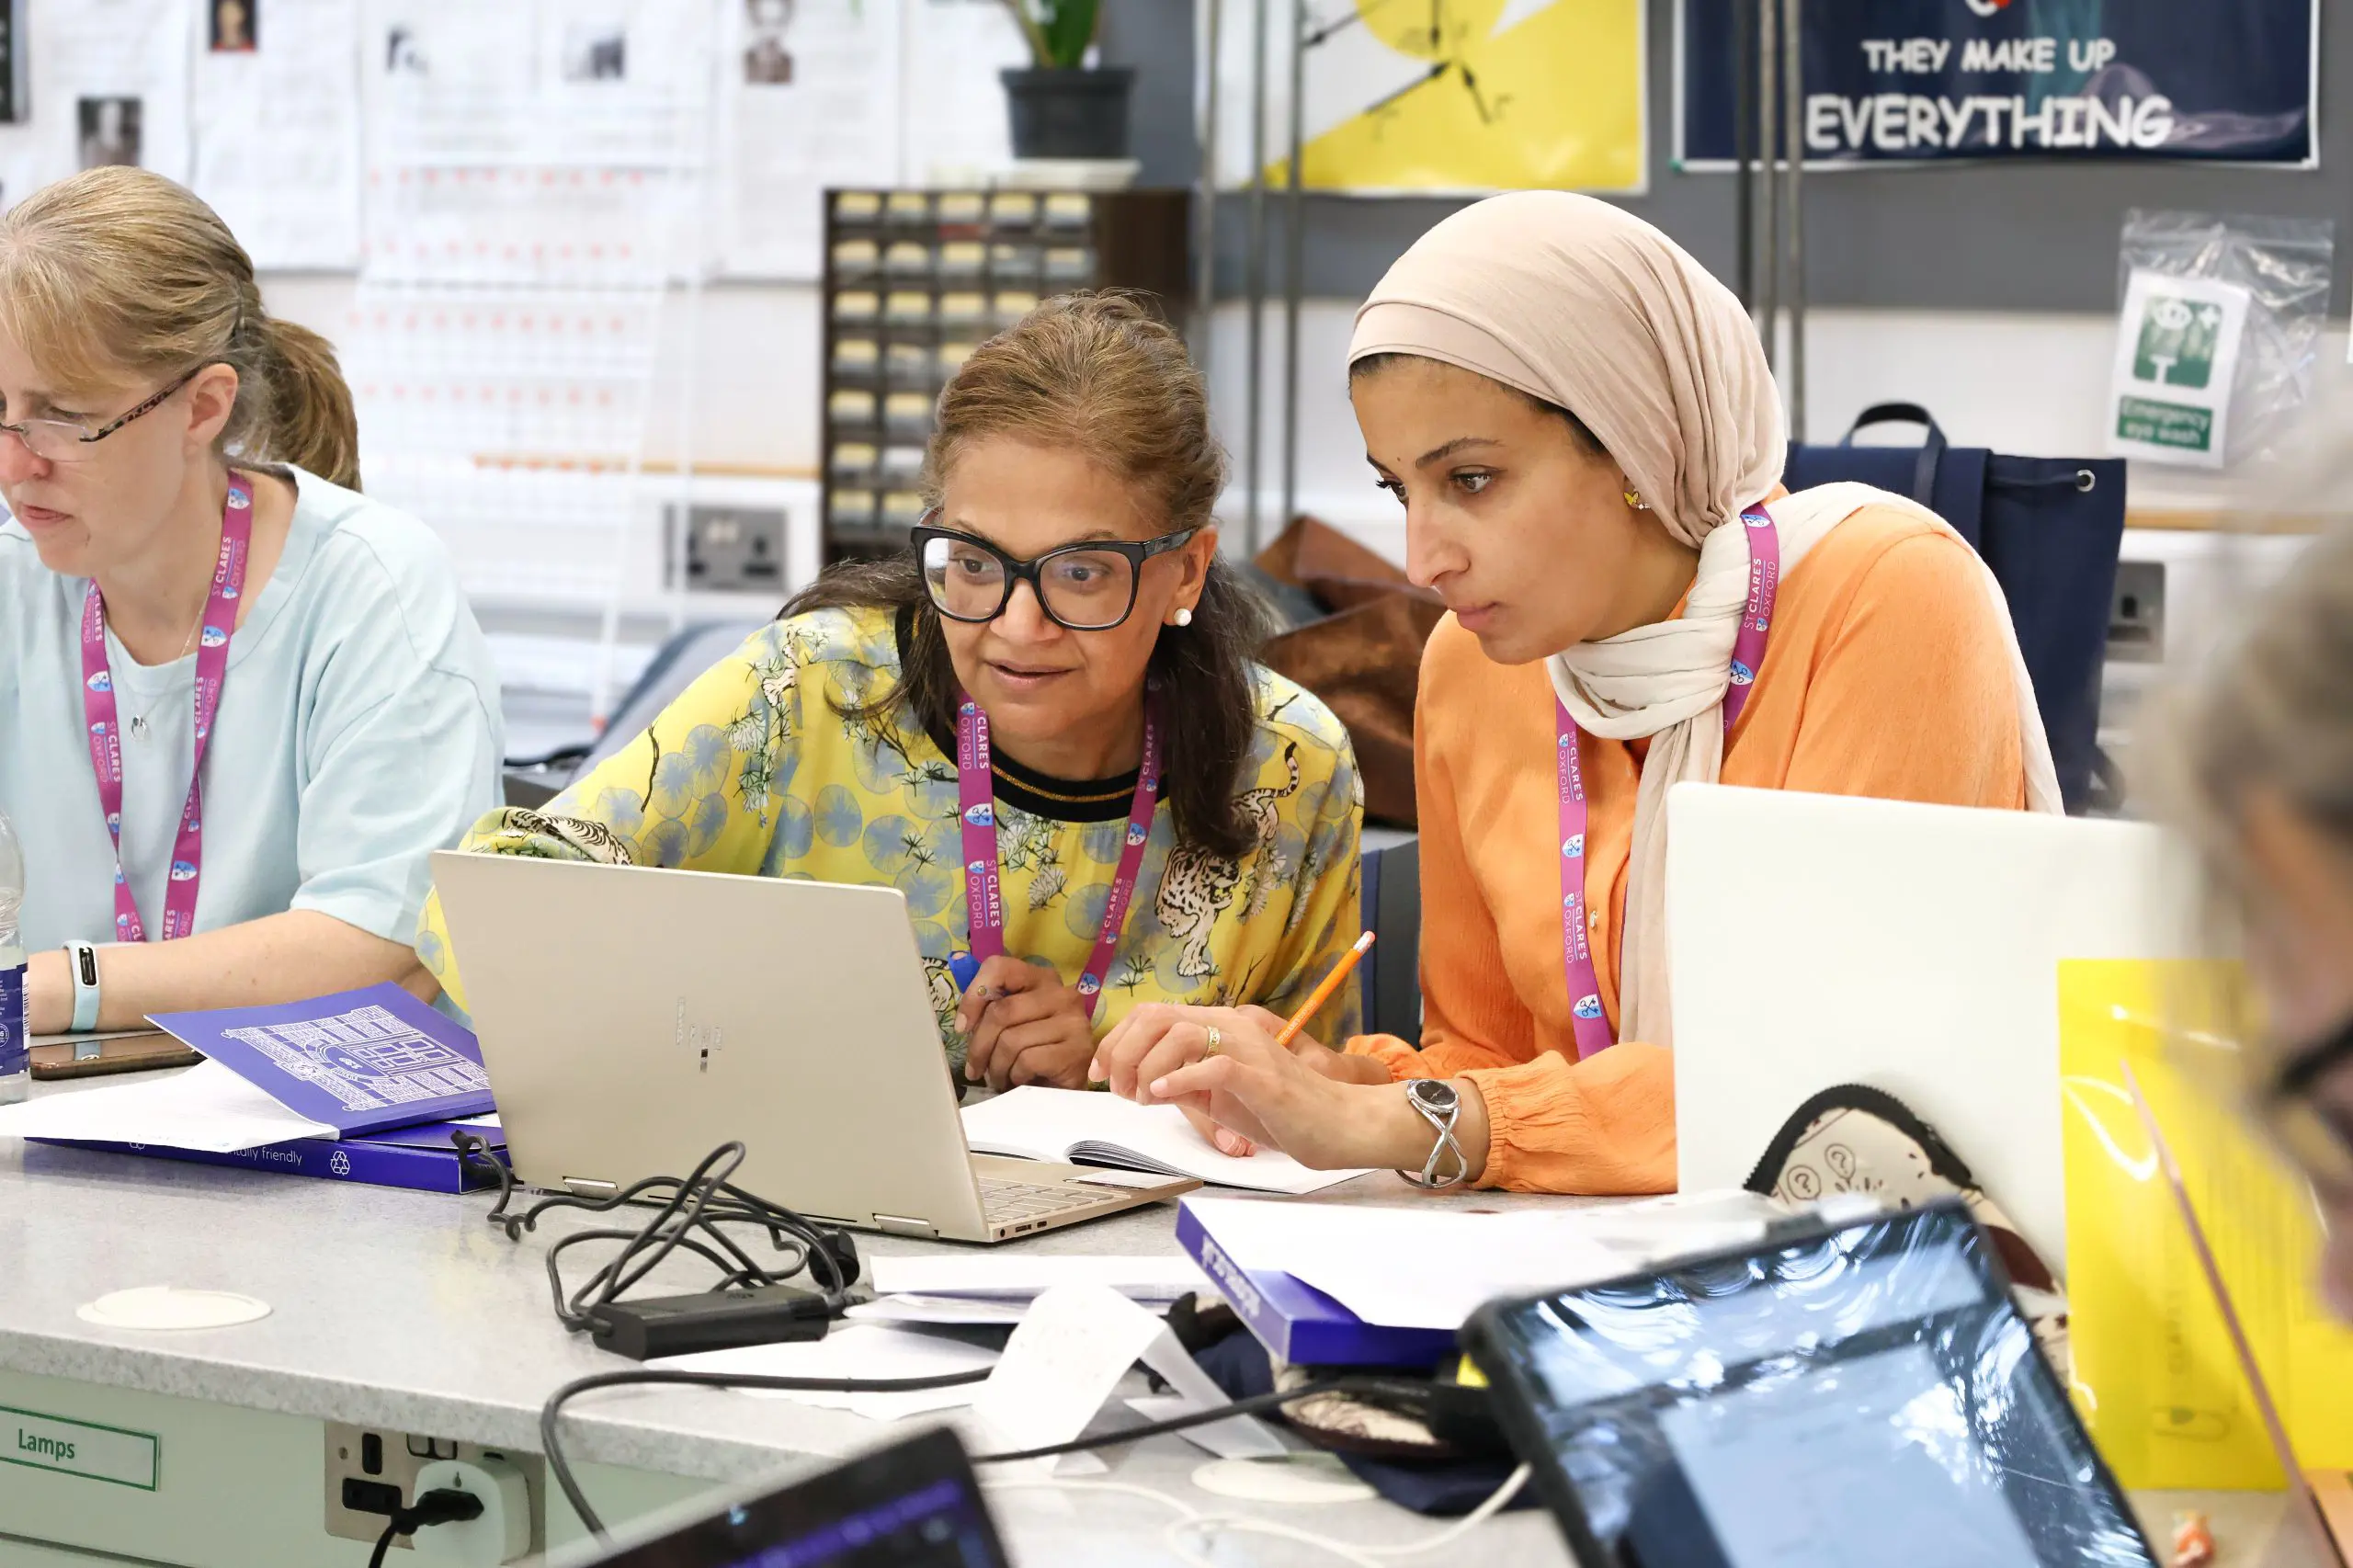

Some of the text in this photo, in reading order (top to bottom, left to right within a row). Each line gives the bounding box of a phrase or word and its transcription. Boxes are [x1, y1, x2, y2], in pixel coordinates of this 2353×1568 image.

[1861, 39, 2117, 73] THEY MAKE UP
[1805, 93, 2175, 149] EVERYTHING
[1762, 561, 1776, 617] OXFORD
[1744, 614, 1755, 630] ST
[961, 717, 972, 770] OXFORD
[1568, 731, 1577, 745] ST
[1559, 750, 1571, 804] OXFORD
[986, 858, 997, 873] ST
[970, 875, 983, 929] OXFORD
[1574, 890, 1584, 903] ST
[1564, 910, 1574, 963] OXFORD
[261, 1146, 302, 1166] friendly
[18, 1428, 75, 1461] Lamps
